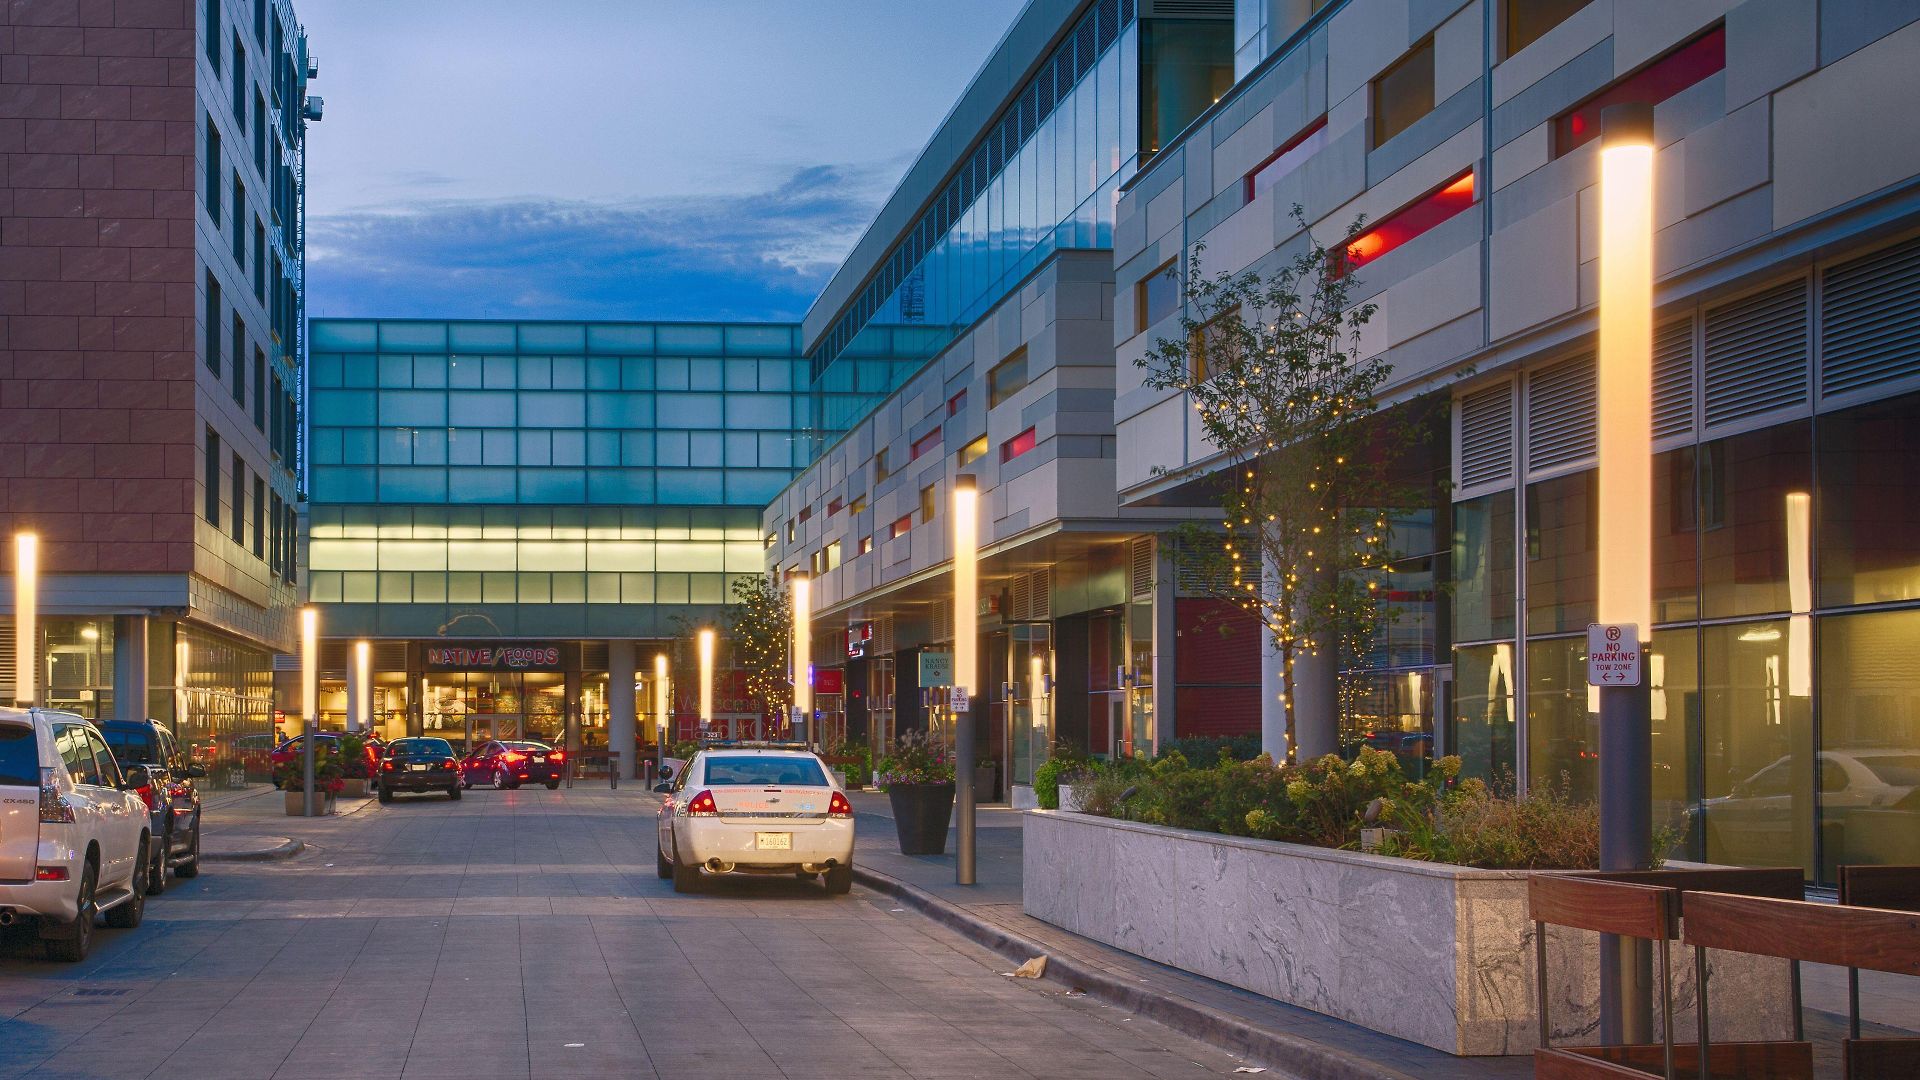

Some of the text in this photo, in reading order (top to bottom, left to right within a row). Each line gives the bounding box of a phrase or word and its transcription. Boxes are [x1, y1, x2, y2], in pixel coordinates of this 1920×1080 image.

[1606, 643, 1620, 652] NO
[428, 647, 492, 665] NATIVE
[503, 647, 559, 665] FOODS
[1592, 652, 1635, 661] PARKING
[680, 696, 761, 712] Wcome
